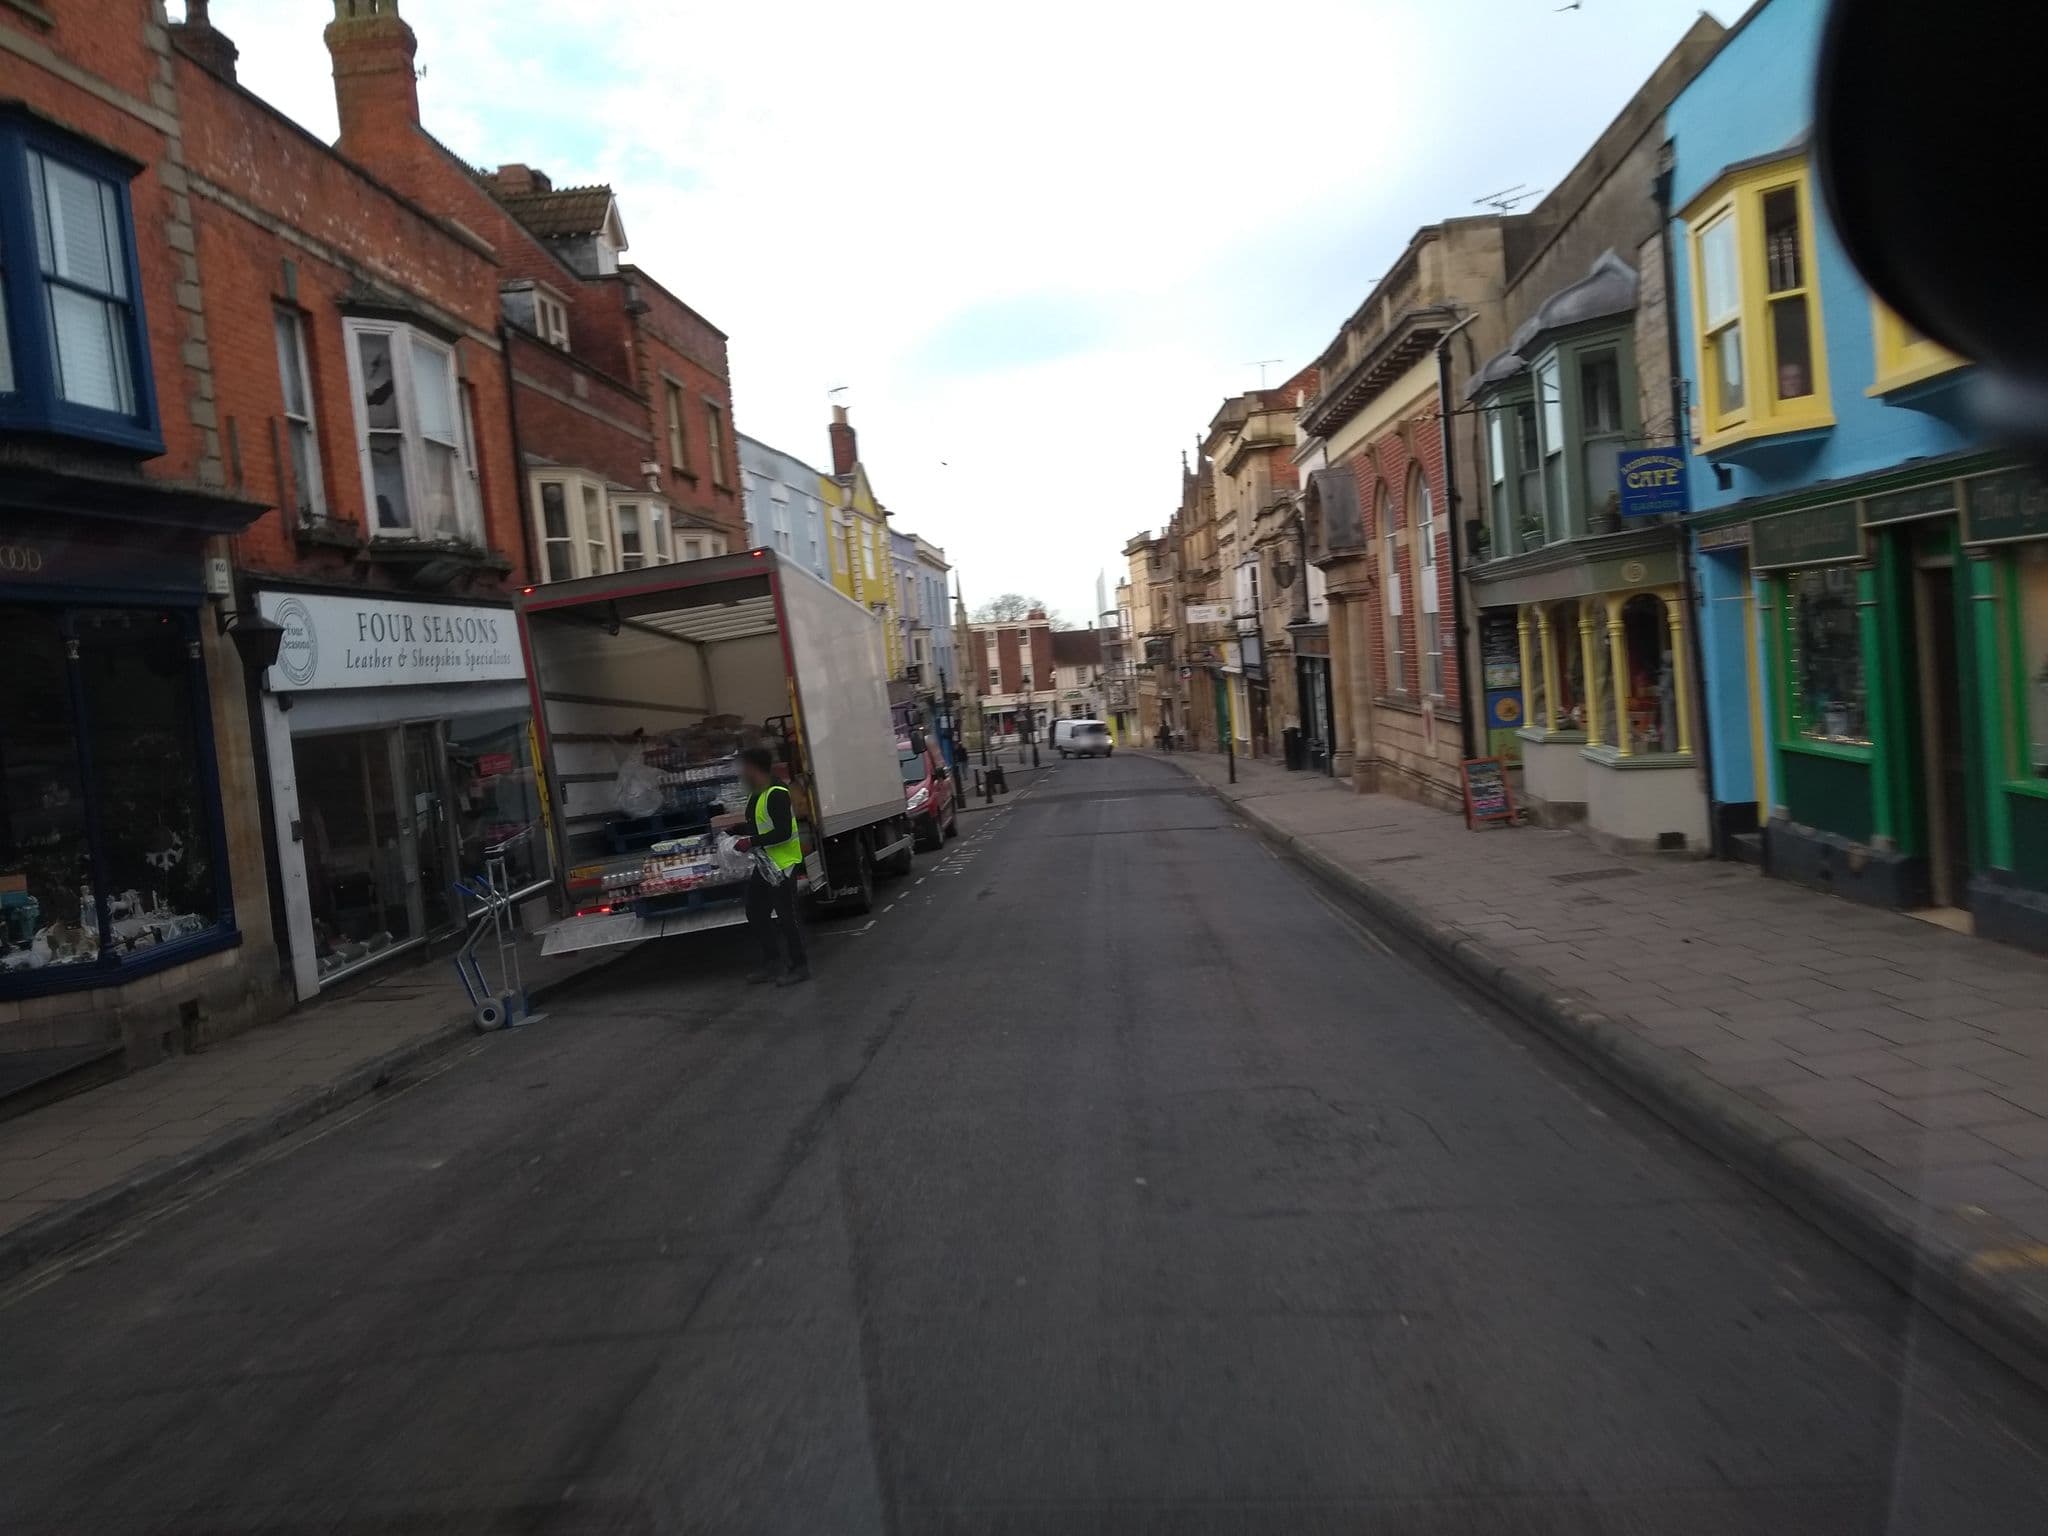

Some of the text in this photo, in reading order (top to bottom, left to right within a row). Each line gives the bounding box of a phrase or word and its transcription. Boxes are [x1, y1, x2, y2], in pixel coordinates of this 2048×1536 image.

[1626, 468, 1680, 488] CAFE
[357, 612, 498, 644] FOUR SEASONS
[346, 648, 511, 672] Leather & Sheepskin Specialists
